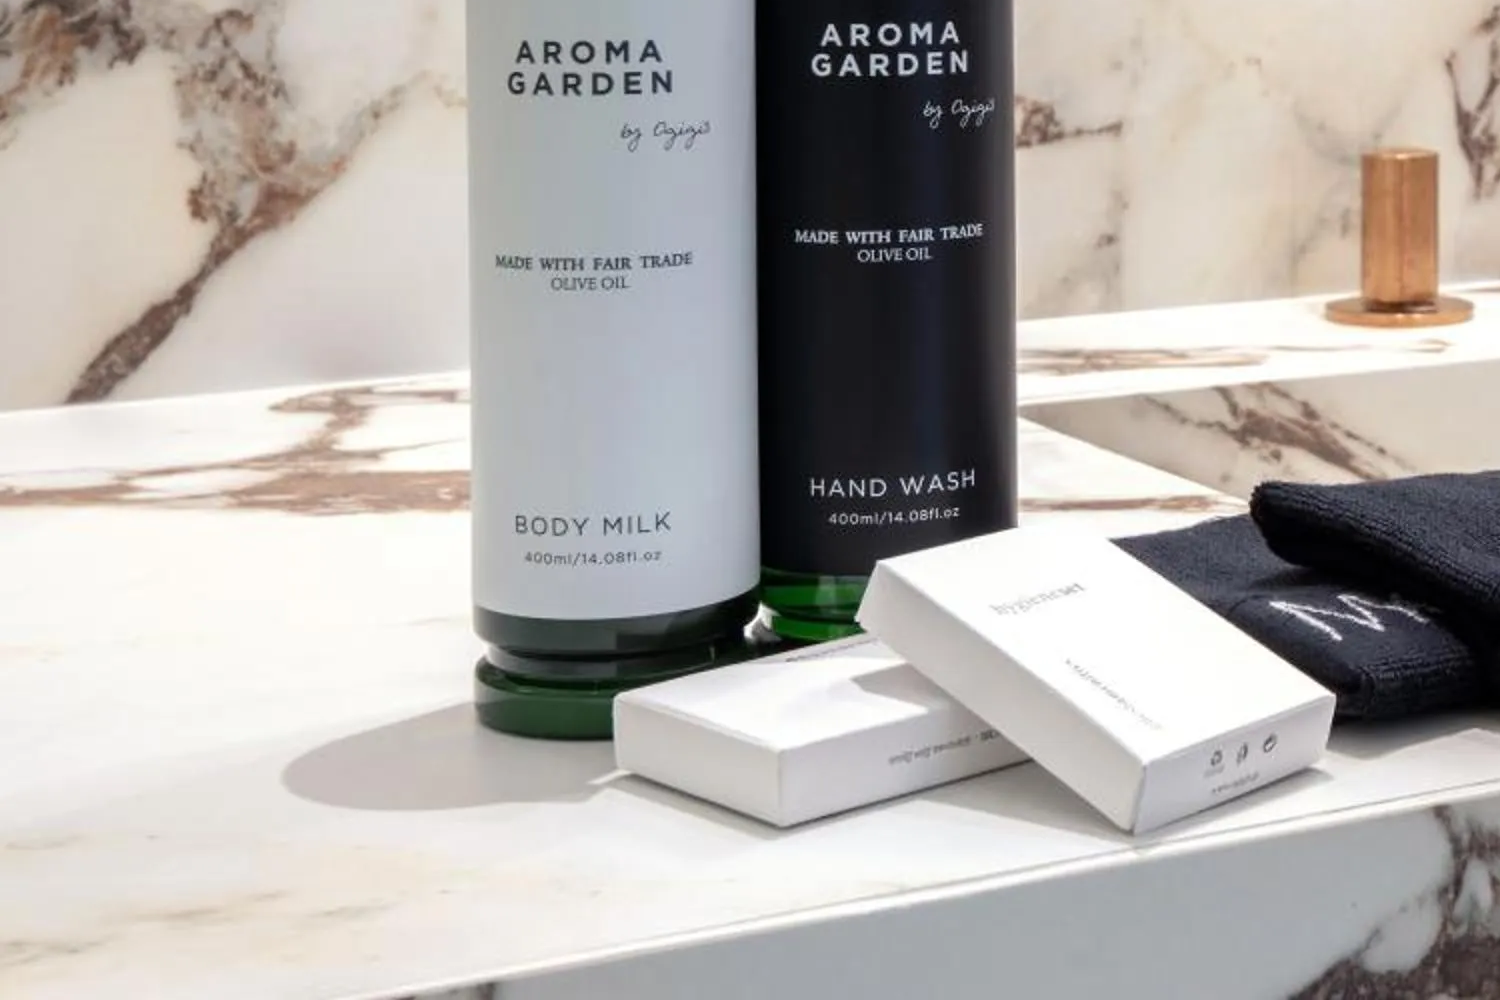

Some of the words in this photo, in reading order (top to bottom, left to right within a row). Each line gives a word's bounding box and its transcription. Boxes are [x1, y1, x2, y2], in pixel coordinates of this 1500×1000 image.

[820, 21, 961, 47] AROMA
[515, 39, 663, 65] AROMA
[811, 50, 969, 77] GARDEN
[507, 70, 673, 96] GARDEN
[923, 101, 943, 129] by
[620, 122, 642, 152] by
[794, 229, 839, 244] MADE
[846, 231, 891, 244] WITH
[899, 228, 935, 243] FAIR
[939, 223, 984, 241] TRADE
[495, 254, 533, 270] MADE
[540, 257, 584, 271] WITH
[593, 256, 632, 270] FAIR
[639, 252, 693, 269] TRADE
[857, 249, 902, 263] OLIVE
[905, 247, 933, 261] OIL
[550, 276, 597, 291] OLIVE
[600, 275, 630, 290] OIL
[810, 477, 888, 498] HAND
[900, 467, 976, 496] WASH
[514, 514, 590, 537] BODY
[602, 510, 672, 537] MILK
